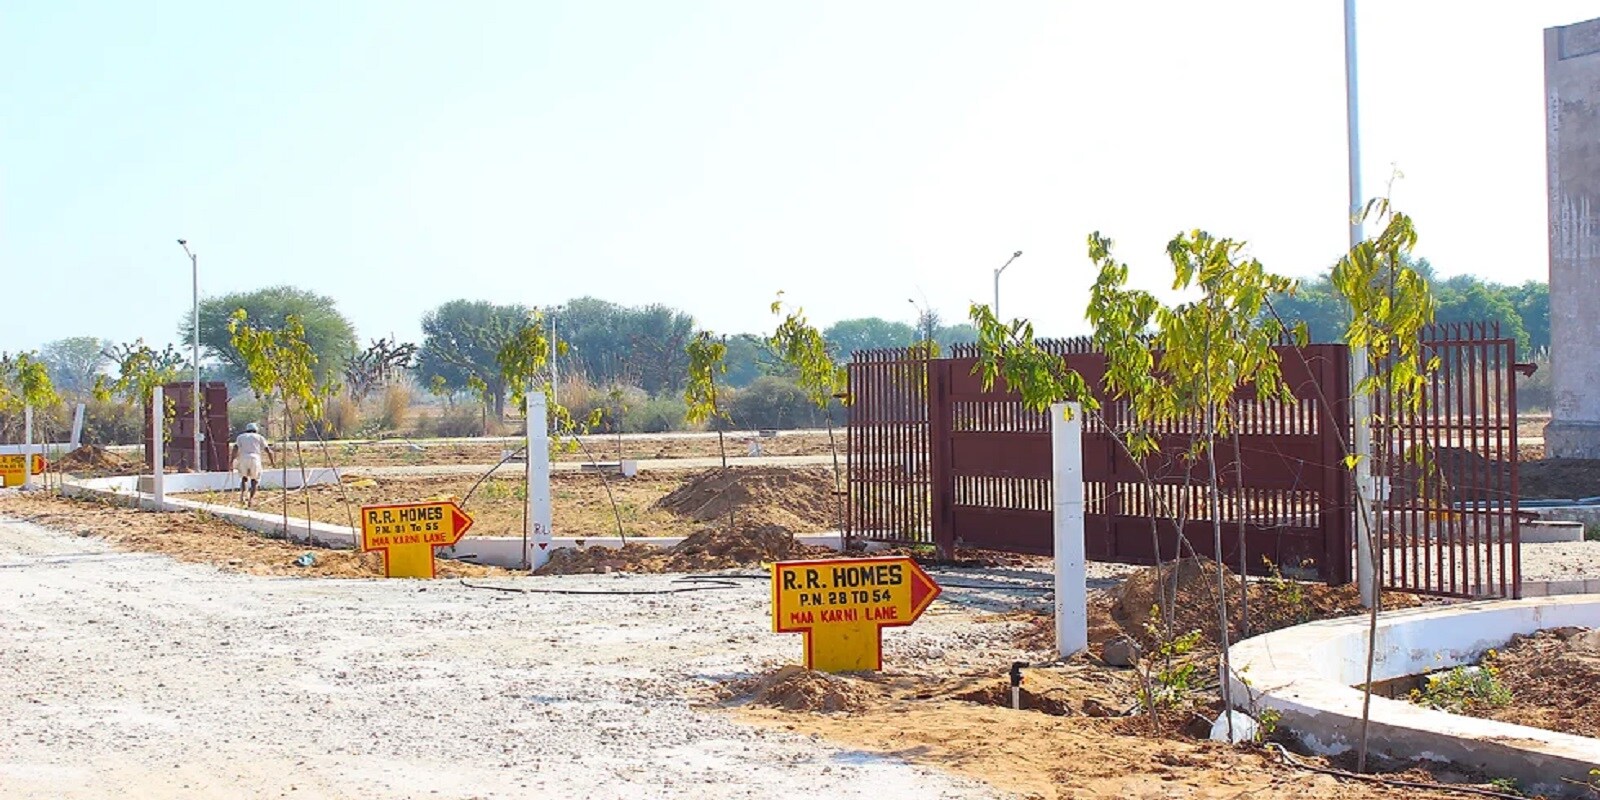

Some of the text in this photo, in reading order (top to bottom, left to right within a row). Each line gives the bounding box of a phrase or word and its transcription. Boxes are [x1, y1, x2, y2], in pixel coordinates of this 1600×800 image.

[400, 507, 443, 522] HOMES
[424, 533, 446, 542] LANE
[833, 565, 902, 588] HOMES
[829, 592, 847, 605] 28
[851, 591, 868, 604] TO
[873, 589, 891, 602] 54
[790, 606, 897, 624] MAA KARNI LANE
